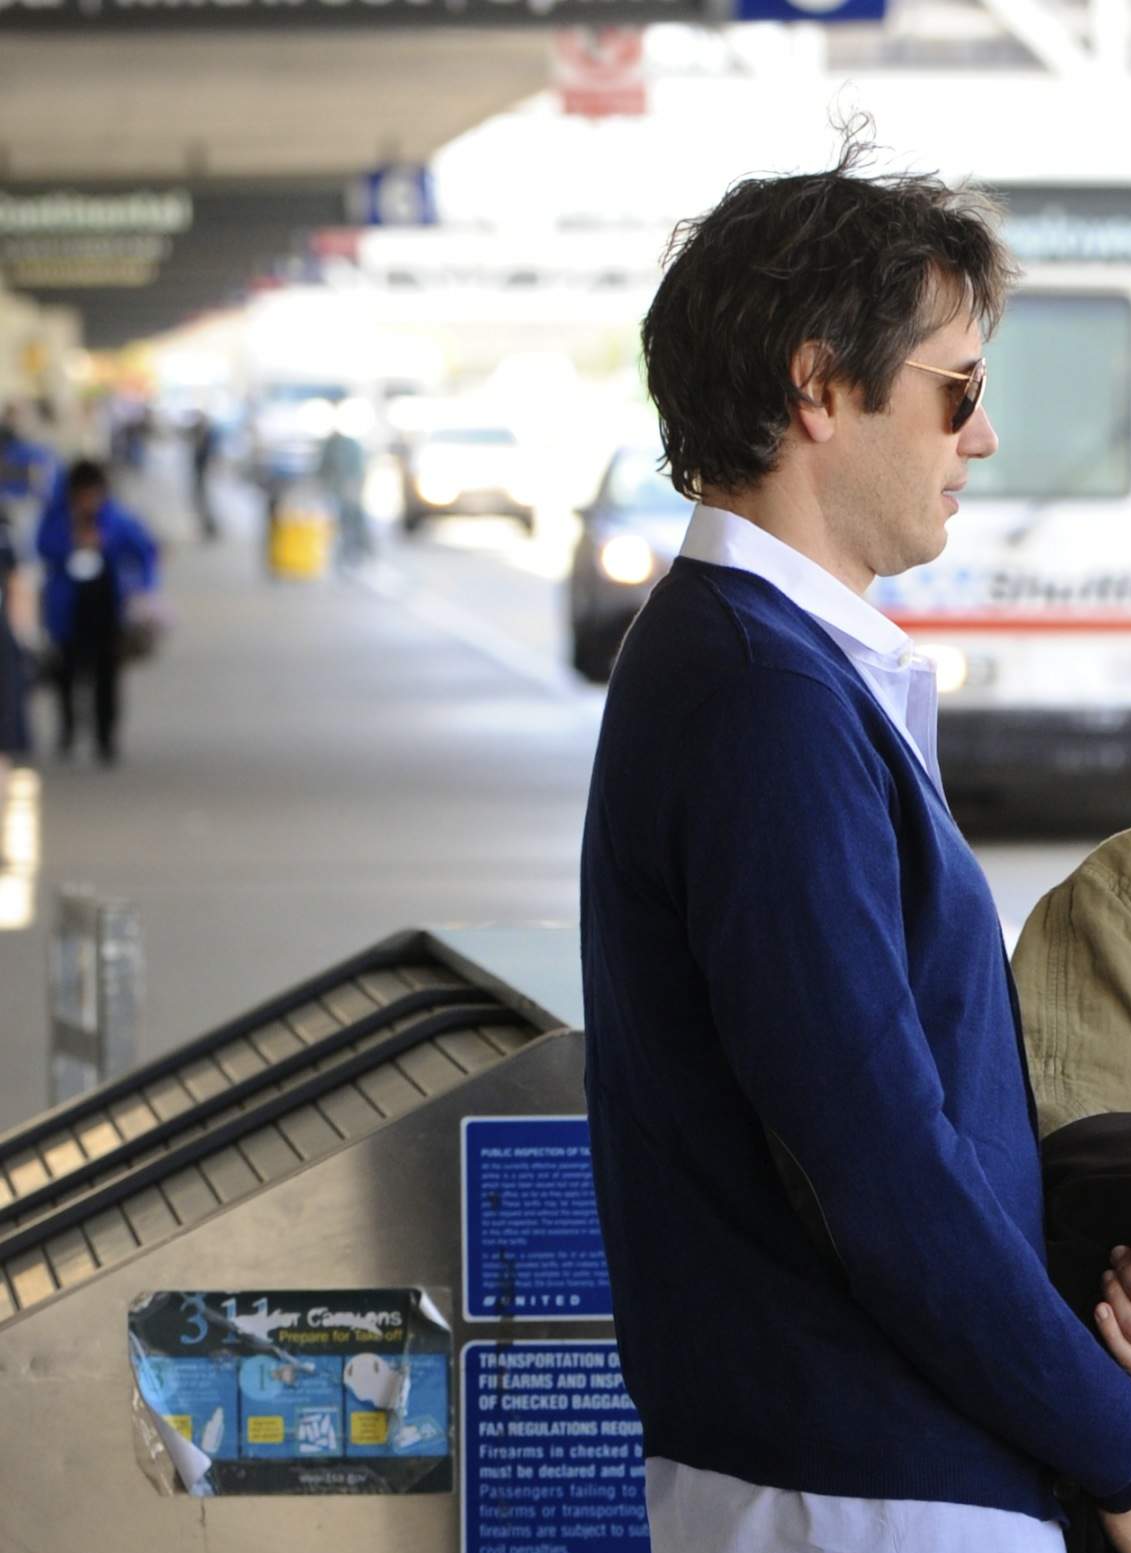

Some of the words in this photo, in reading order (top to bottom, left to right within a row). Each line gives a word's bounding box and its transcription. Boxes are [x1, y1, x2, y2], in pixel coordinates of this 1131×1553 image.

[501, 1294, 581, 1307] UNITED
[278, 1329, 329, 1345] Prepare
[479, 1352, 605, 1369] TRANSPORTATION
[607, 1352, 621, 1369] O
[557, 1373, 587, 1389] AND
[590, 1373, 626, 1389] INSP
[479, 1394, 497, 1410] OF
[501, 1394, 568, 1410] CHECKED
[572, 1394, 637, 1410] BAGGAG
[479, 1421, 504, 1436] FAA
[508, 1421, 598, 1436] REGULATIONS
[479, 1444, 544, 1458] Firearms
[550, 1444, 564, 1458] in
[569, 1444, 628, 1458] checked
[479, 1464, 512, 1478] must
[516, 1464, 533, 1478] be
[538, 1464, 596, 1478] declared
[600, 1464, 625, 1478] and
[479, 1484, 563, 1500] Passengers
[570, 1483, 616, 1501] failing
[622, 1484, 637, 1497] to
[479, 1504, 536, 1518] firearms
[542, 1507, 556, 1518] or
[562, 1504, 645, 1520] transporting
[479, 1524, 532, 1538] firearms
[536, 1527, 557, 1538] are
[560, 1524, 606, 1540] subject
[610, 1524, 624, 1538] to
